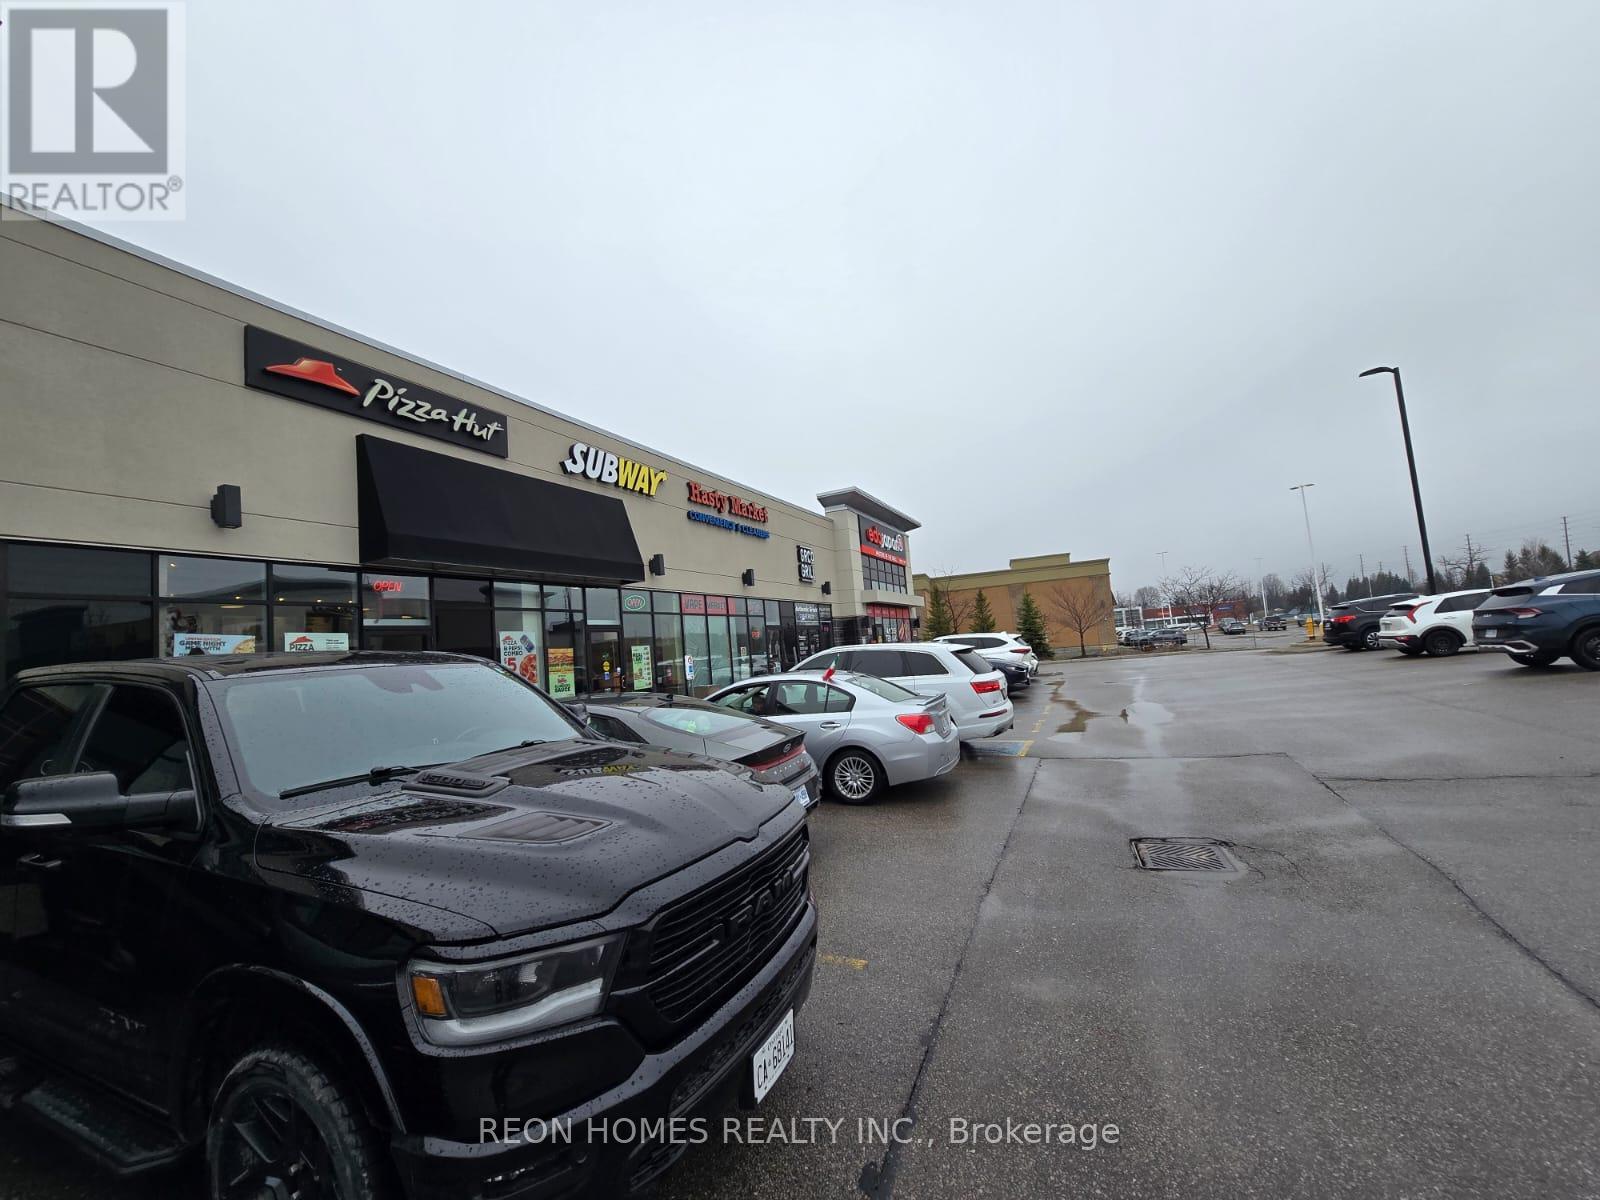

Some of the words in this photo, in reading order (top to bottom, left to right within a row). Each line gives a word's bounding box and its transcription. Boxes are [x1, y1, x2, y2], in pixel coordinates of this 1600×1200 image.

[363, 378, 449, 422] Pizza
[452, 408, 504, 441] Hut
[563, 443, 669, 497] SUBWAY
[729, 496, 768, 523] Market
[373, 580, 402, 592] OPEN
[290, 643, 314, 651] PIZZA
